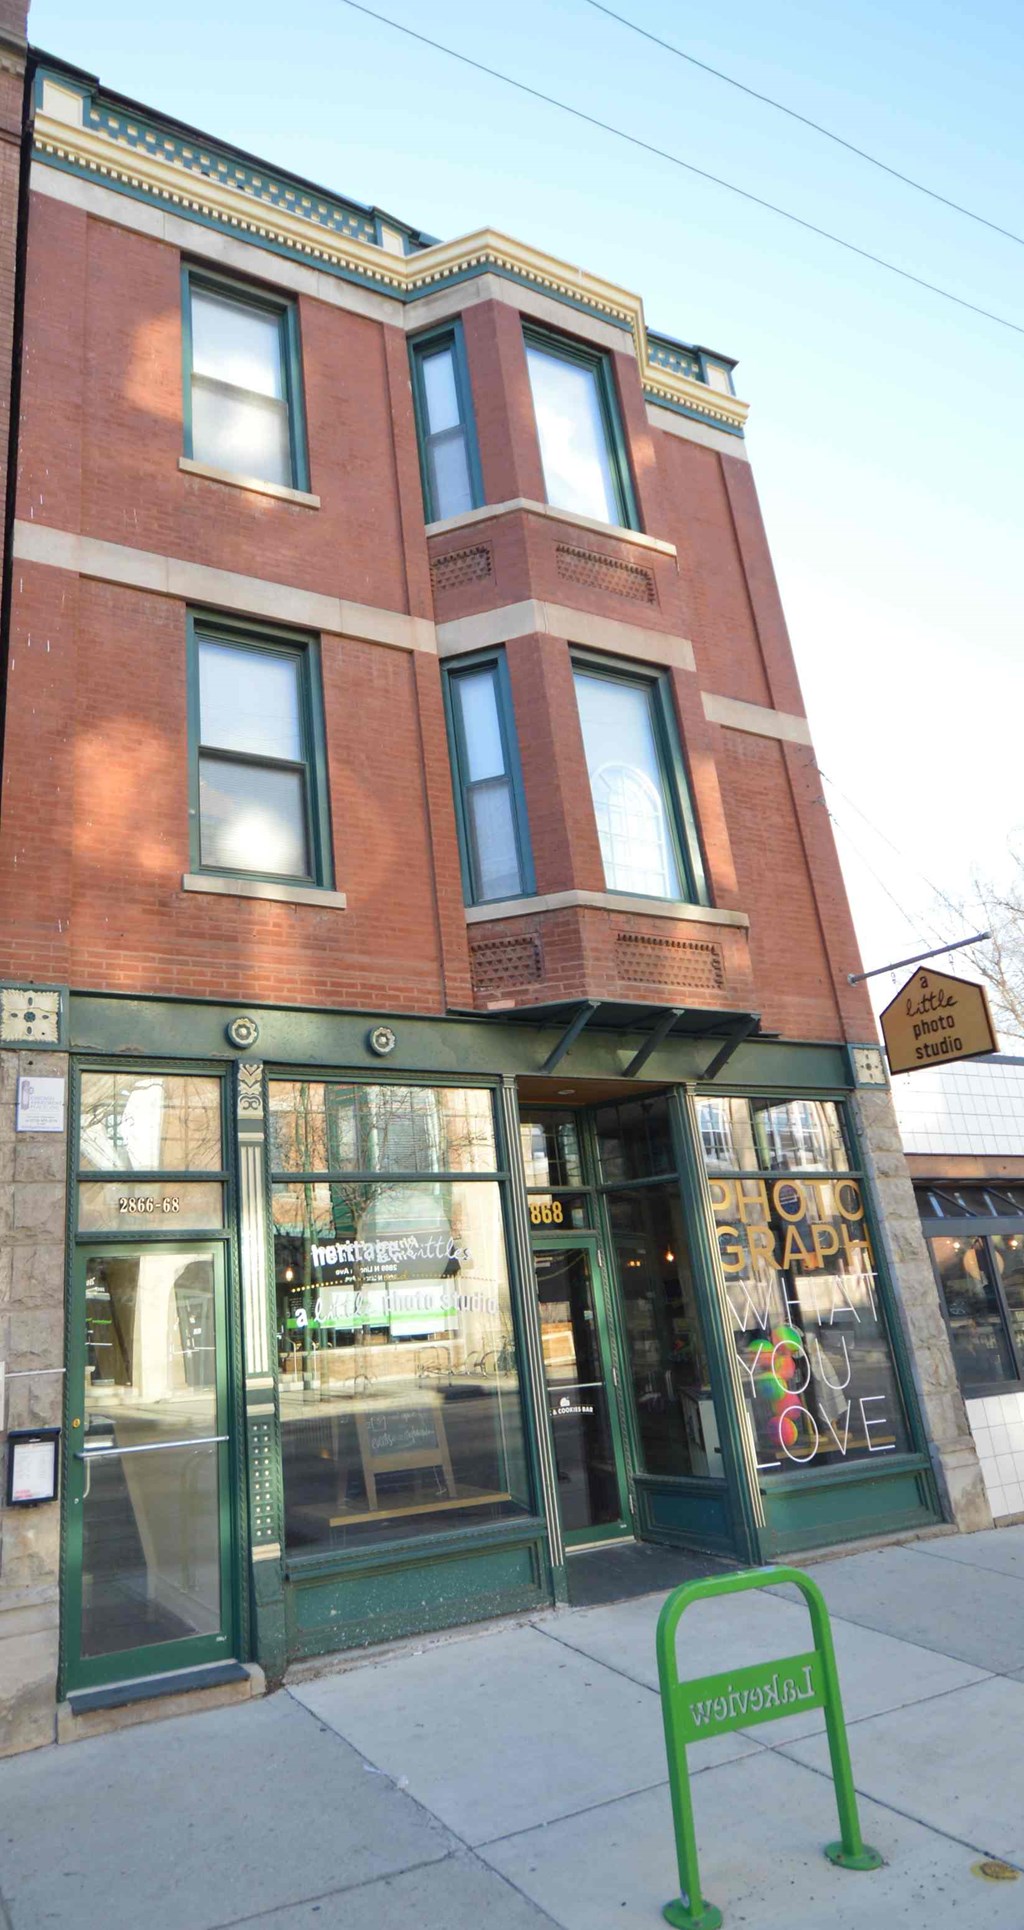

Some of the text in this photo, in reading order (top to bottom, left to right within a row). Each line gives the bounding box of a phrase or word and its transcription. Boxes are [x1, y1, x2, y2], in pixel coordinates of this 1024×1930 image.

[919, 976, 928, 988] a
[906, 989, 958, 1017] little
[912, 1015, 955, 1040] photo
[915, 1036, 963, 1060] studio
[119, 1197, 180, 1213] 2866-68
[708, 1179, 864, 1223] PHOTO
[715, 1225, 875, 1272] GRAPH
[295, 1308, 308, 1327] a
[383, 1289, 434, 1317] photo
[440, 1291, 497, 1315] studio
[726, 1272, 878, 1332] WHAT
[737, 1335, 850, 1399] YOU
[746, 1395, 895, 1469] LOVE
